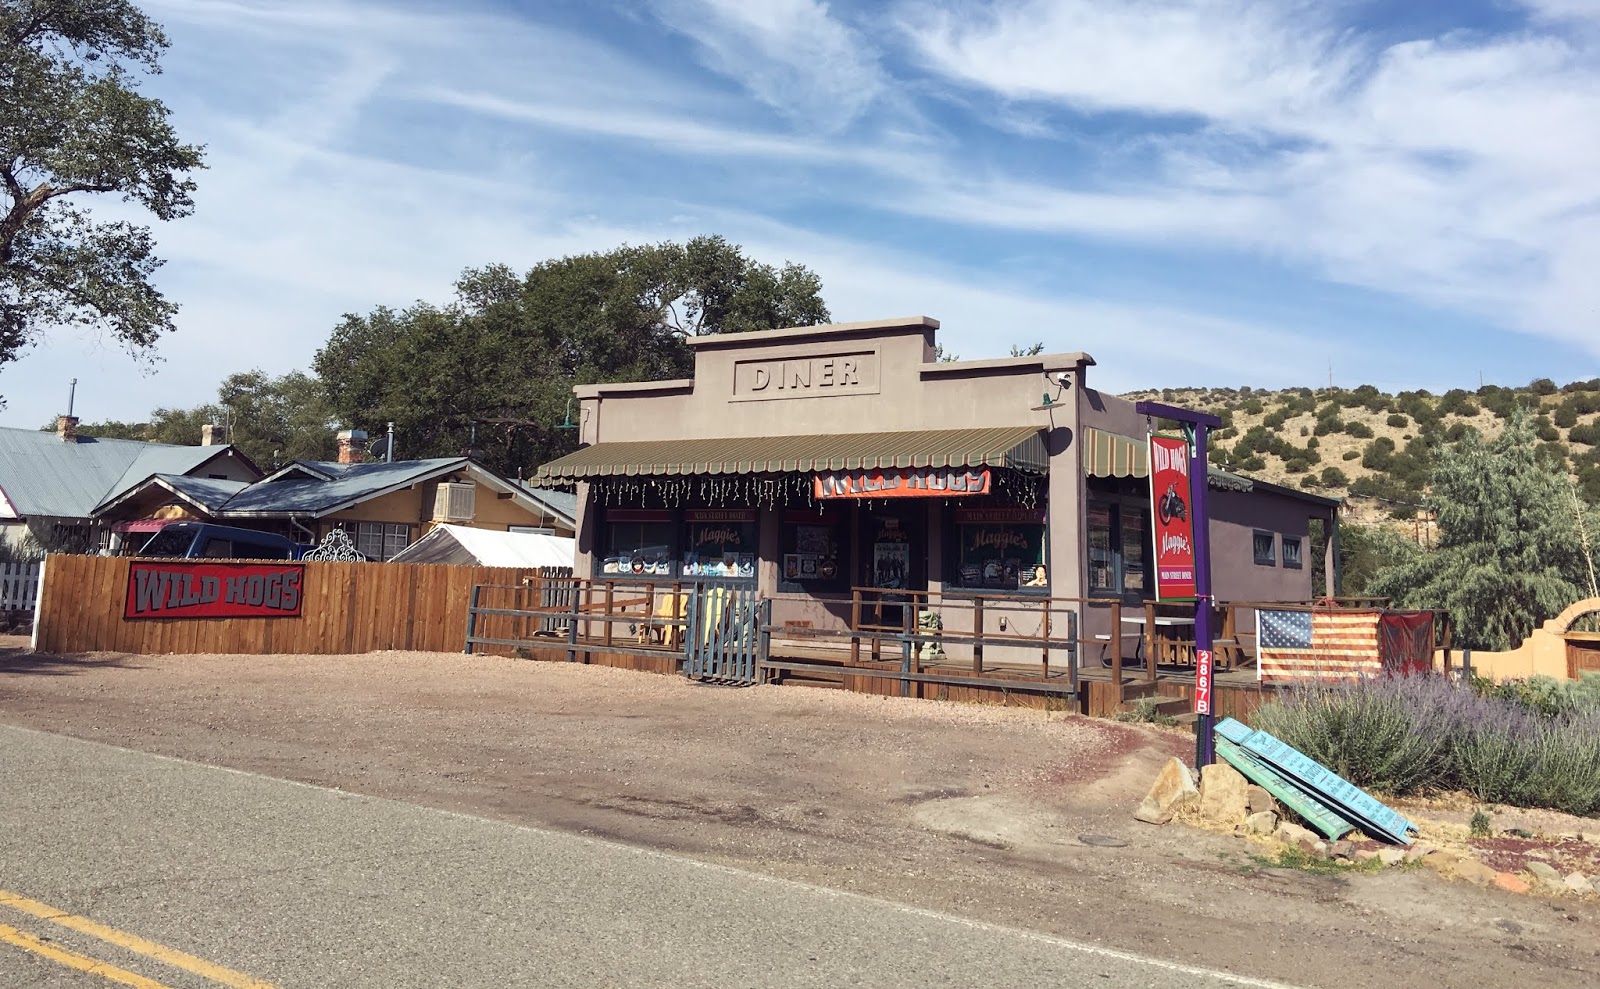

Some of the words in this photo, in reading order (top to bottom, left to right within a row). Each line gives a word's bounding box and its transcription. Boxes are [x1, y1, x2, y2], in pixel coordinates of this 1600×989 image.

[751, 358, 859, 391] DINER
[1152, 440, 1169, 474] WILD
[1169, 444, 1187, 477] HOGS
[820, 467, 899, 496] WILD
[906, 465, 984, 492] HOGS
[708, 511, 728, 519] STREET
[729, 511, 746, 519] DINER
[695, 526, 741, 547] Maggie's
[969, 529, 1029, 552] Maggie's
[1160, 531, 1191, 559] Maggie's
[1161, 571, 1170, 579] MAIN
[1170, 571, 1181, 579] STREET
[1181, 571, 1192, 579] DINER
[135, 569, 220, 613] WILD
[225, 570, 299, 611] HOGS
[1197, 651, 1209, 713] 2867B
